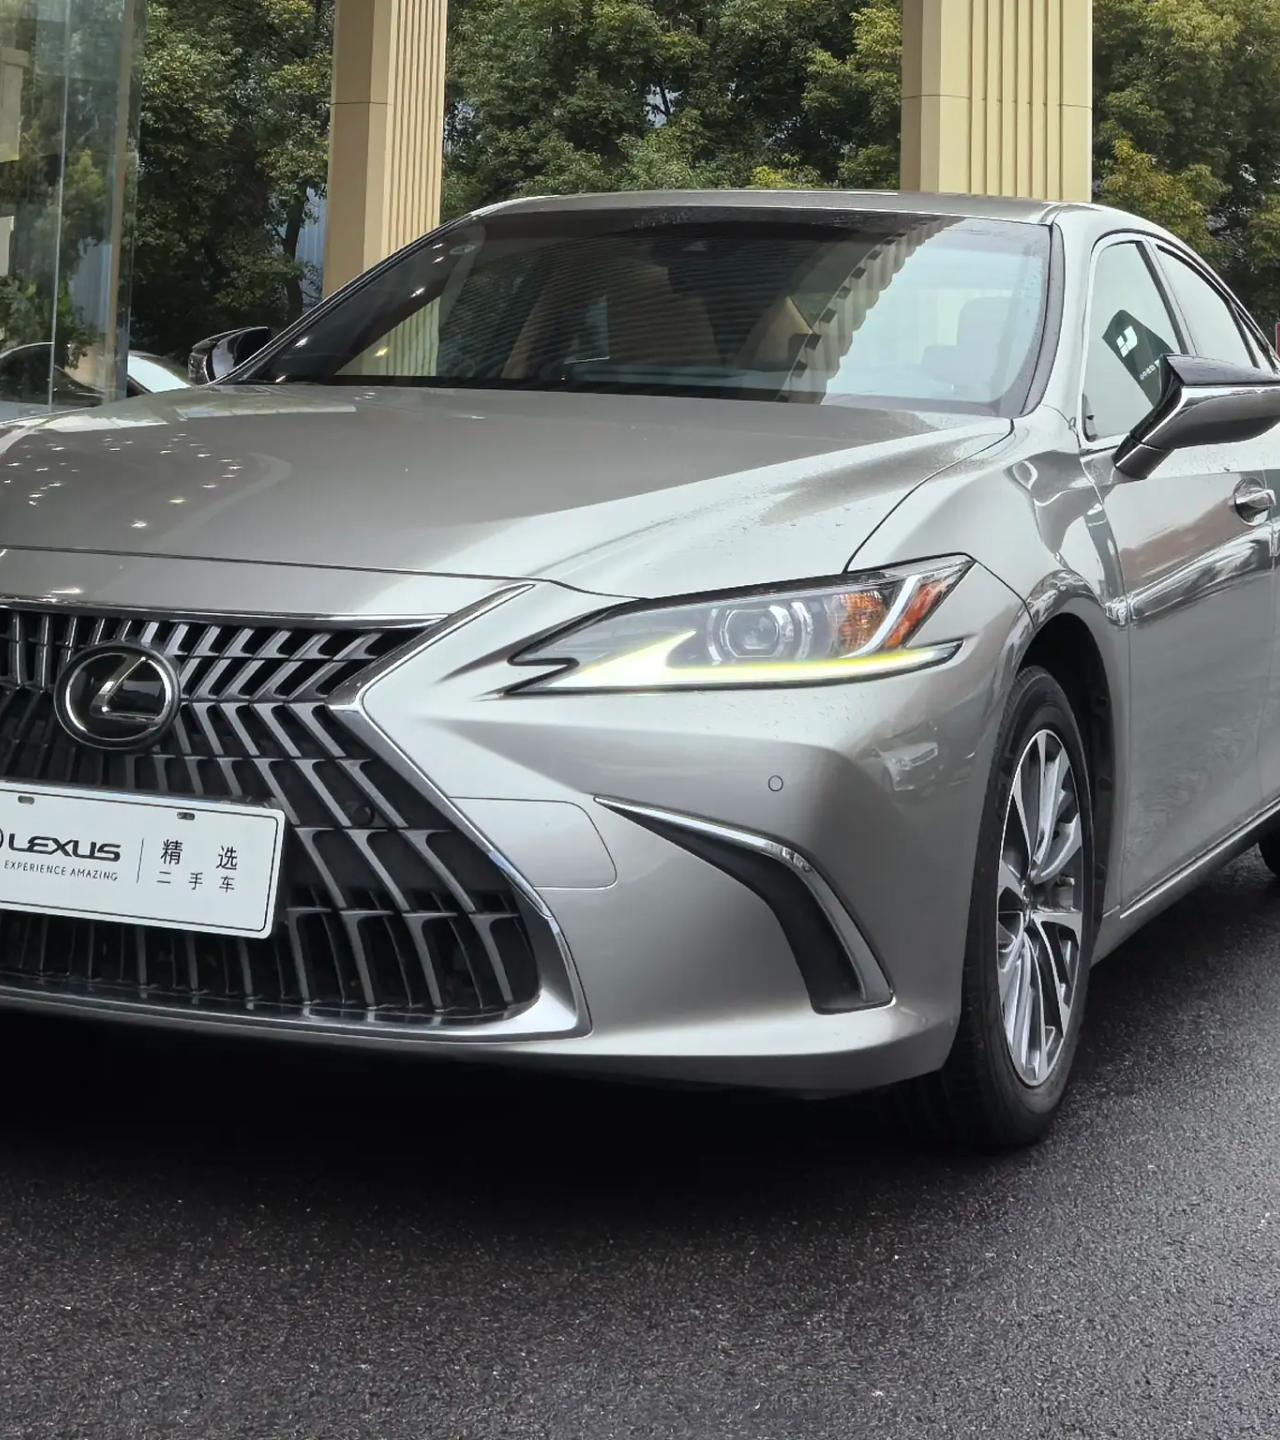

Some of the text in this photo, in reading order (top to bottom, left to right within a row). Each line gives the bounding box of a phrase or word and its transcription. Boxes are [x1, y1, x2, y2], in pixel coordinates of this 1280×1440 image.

[8, 833, 121, 863] LEXUS
[4, 859, 119, 882] EXPERIENCE AMAZING
